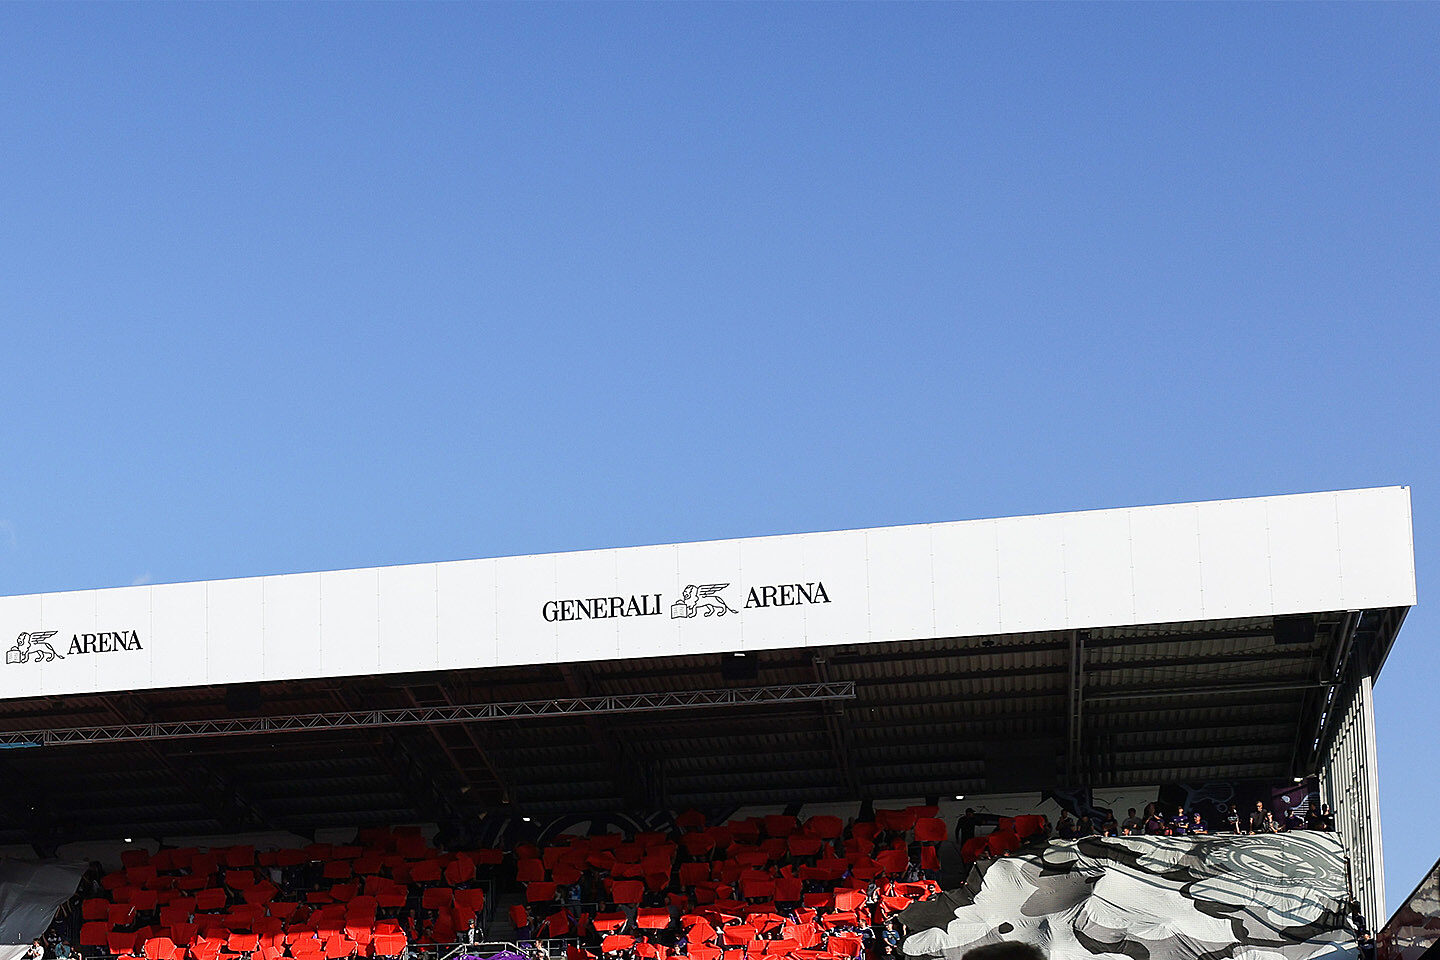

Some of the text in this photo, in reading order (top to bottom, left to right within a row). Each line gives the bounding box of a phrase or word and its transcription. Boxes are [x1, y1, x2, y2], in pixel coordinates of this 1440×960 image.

[543, 582, 831, 622] GENERALI ARENA
[67, 630, 143, 654] ARENA
